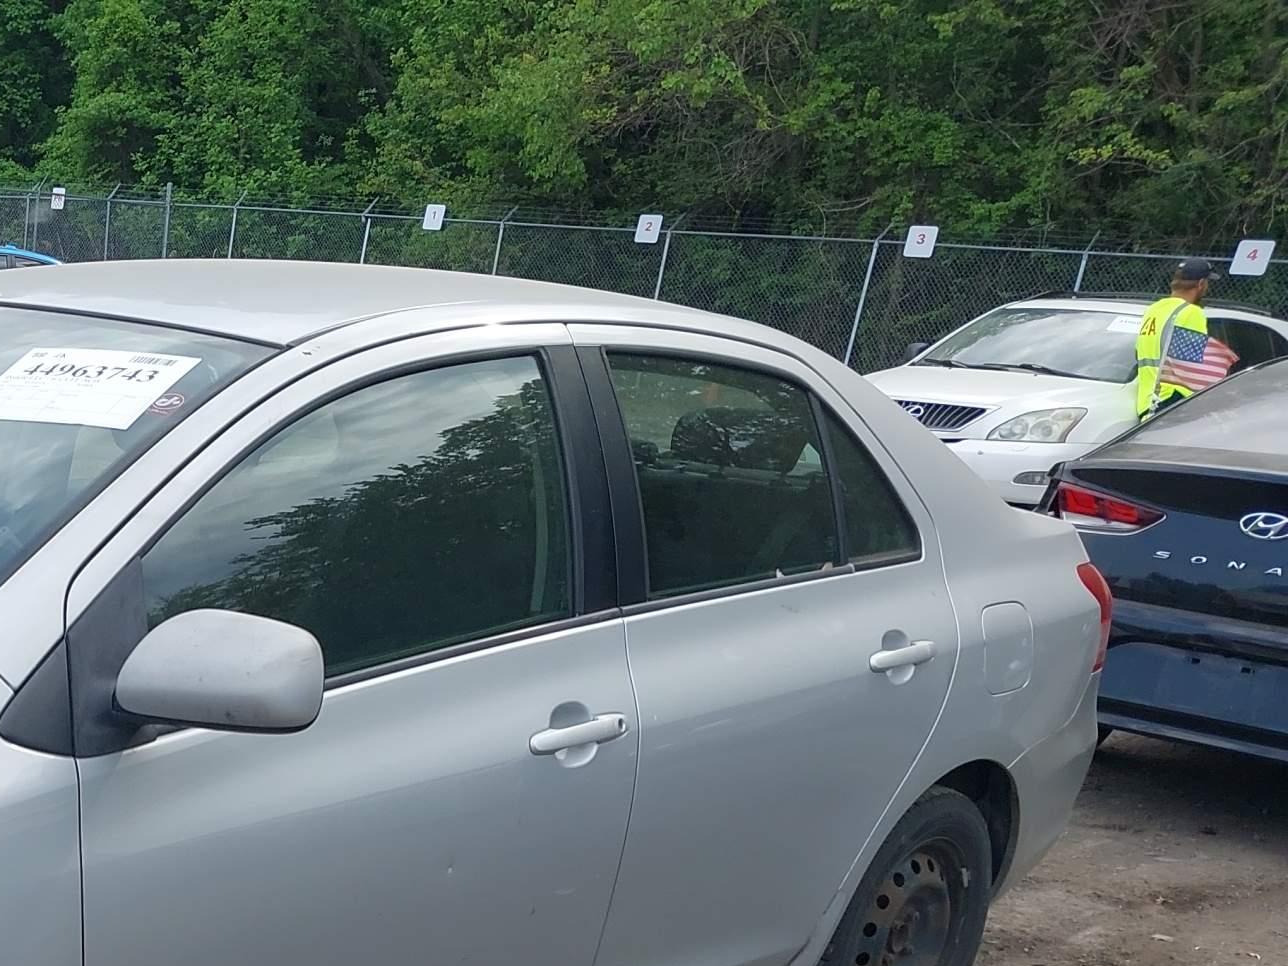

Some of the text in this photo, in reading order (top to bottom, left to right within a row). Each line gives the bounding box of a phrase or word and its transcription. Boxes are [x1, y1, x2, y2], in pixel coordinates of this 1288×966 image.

[644, 221, 653, 232] 2
[916, 233, 926, 245] 3
[1246, 248, 1258, 261] 4
[24, 362, 160, 383] 44963743
